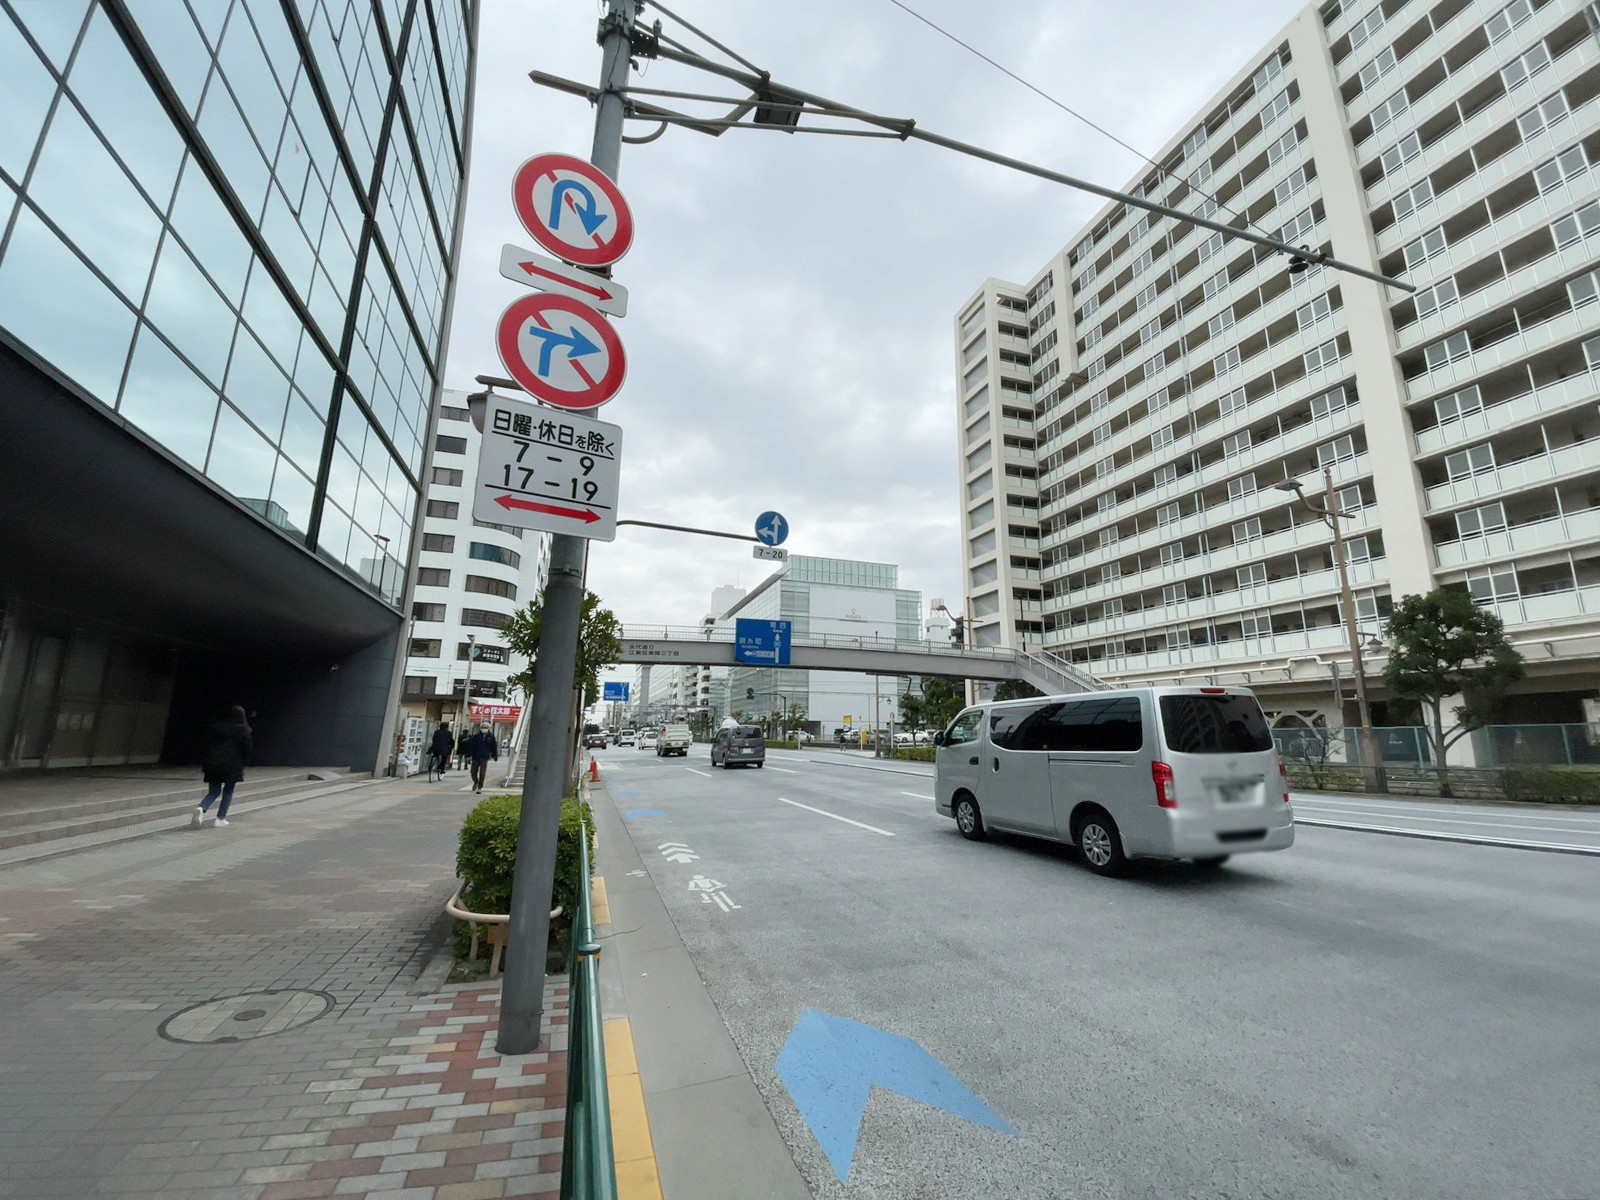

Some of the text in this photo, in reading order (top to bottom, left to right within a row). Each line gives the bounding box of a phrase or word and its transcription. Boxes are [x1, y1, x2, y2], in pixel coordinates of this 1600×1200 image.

[493, 409, 615, 456] 日曜・休日を除く
